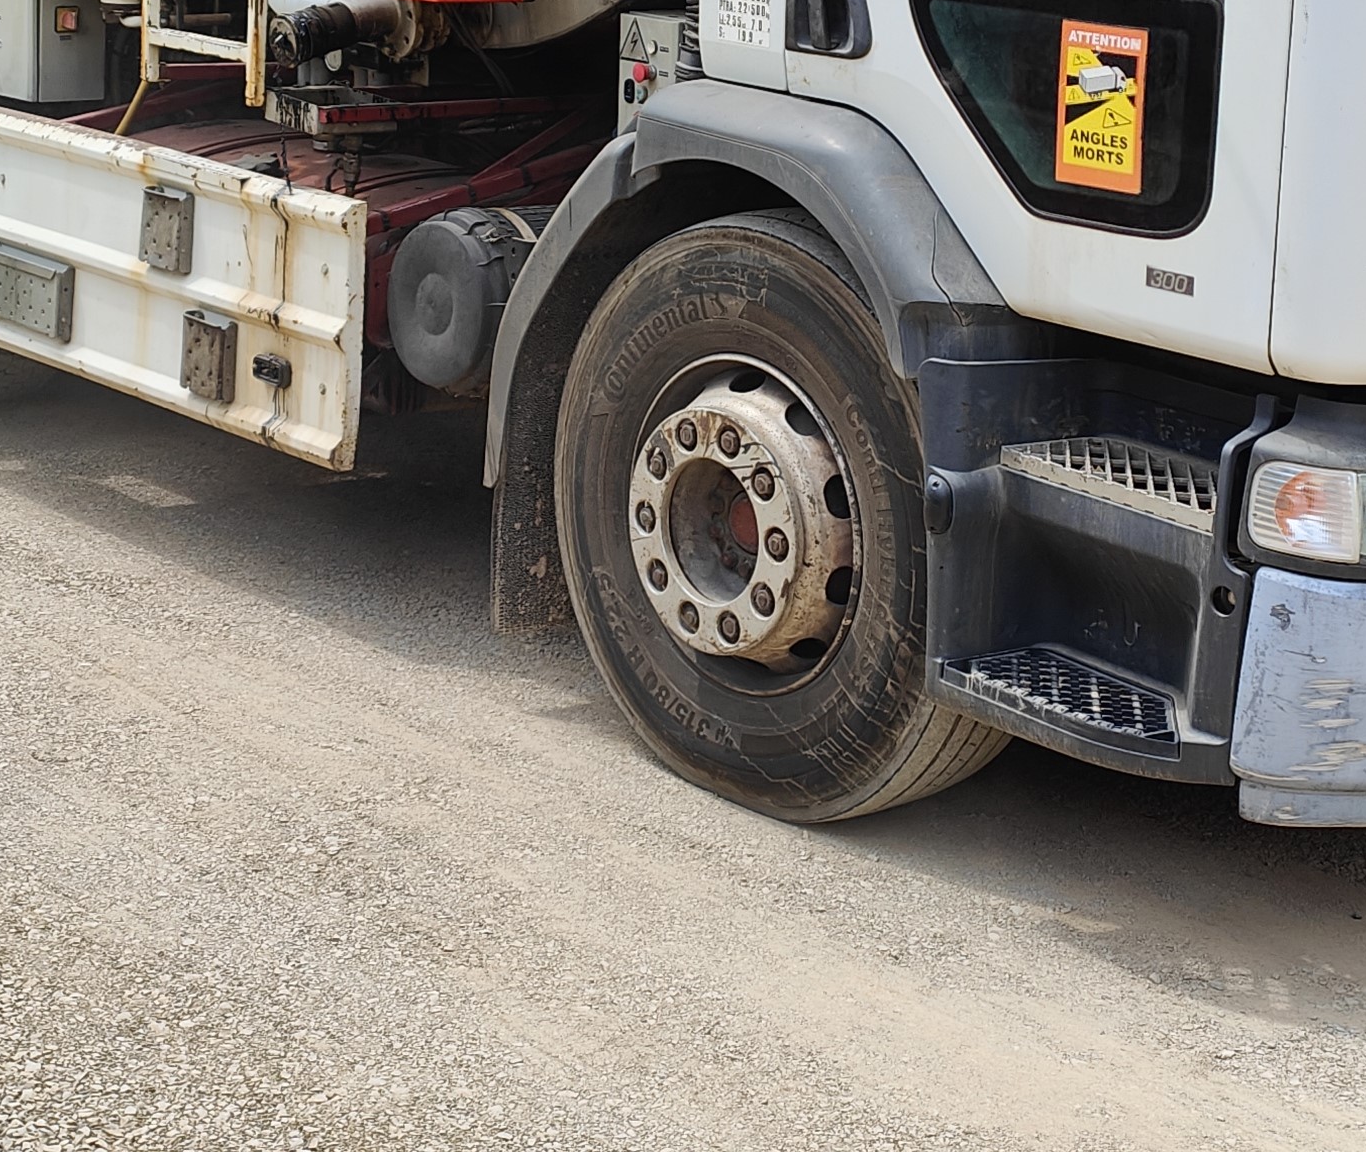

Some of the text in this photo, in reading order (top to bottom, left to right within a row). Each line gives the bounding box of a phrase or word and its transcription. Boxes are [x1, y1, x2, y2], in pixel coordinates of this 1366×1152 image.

[1068, 30, 1141, 50] ATTENTION
[1070, 129, 1128, 149] ANGLES
[1073, 146, 1124, 165] MORTS
[1151, 270, 1188, 292] 300
[644, 670, 712, 741] 315/80
